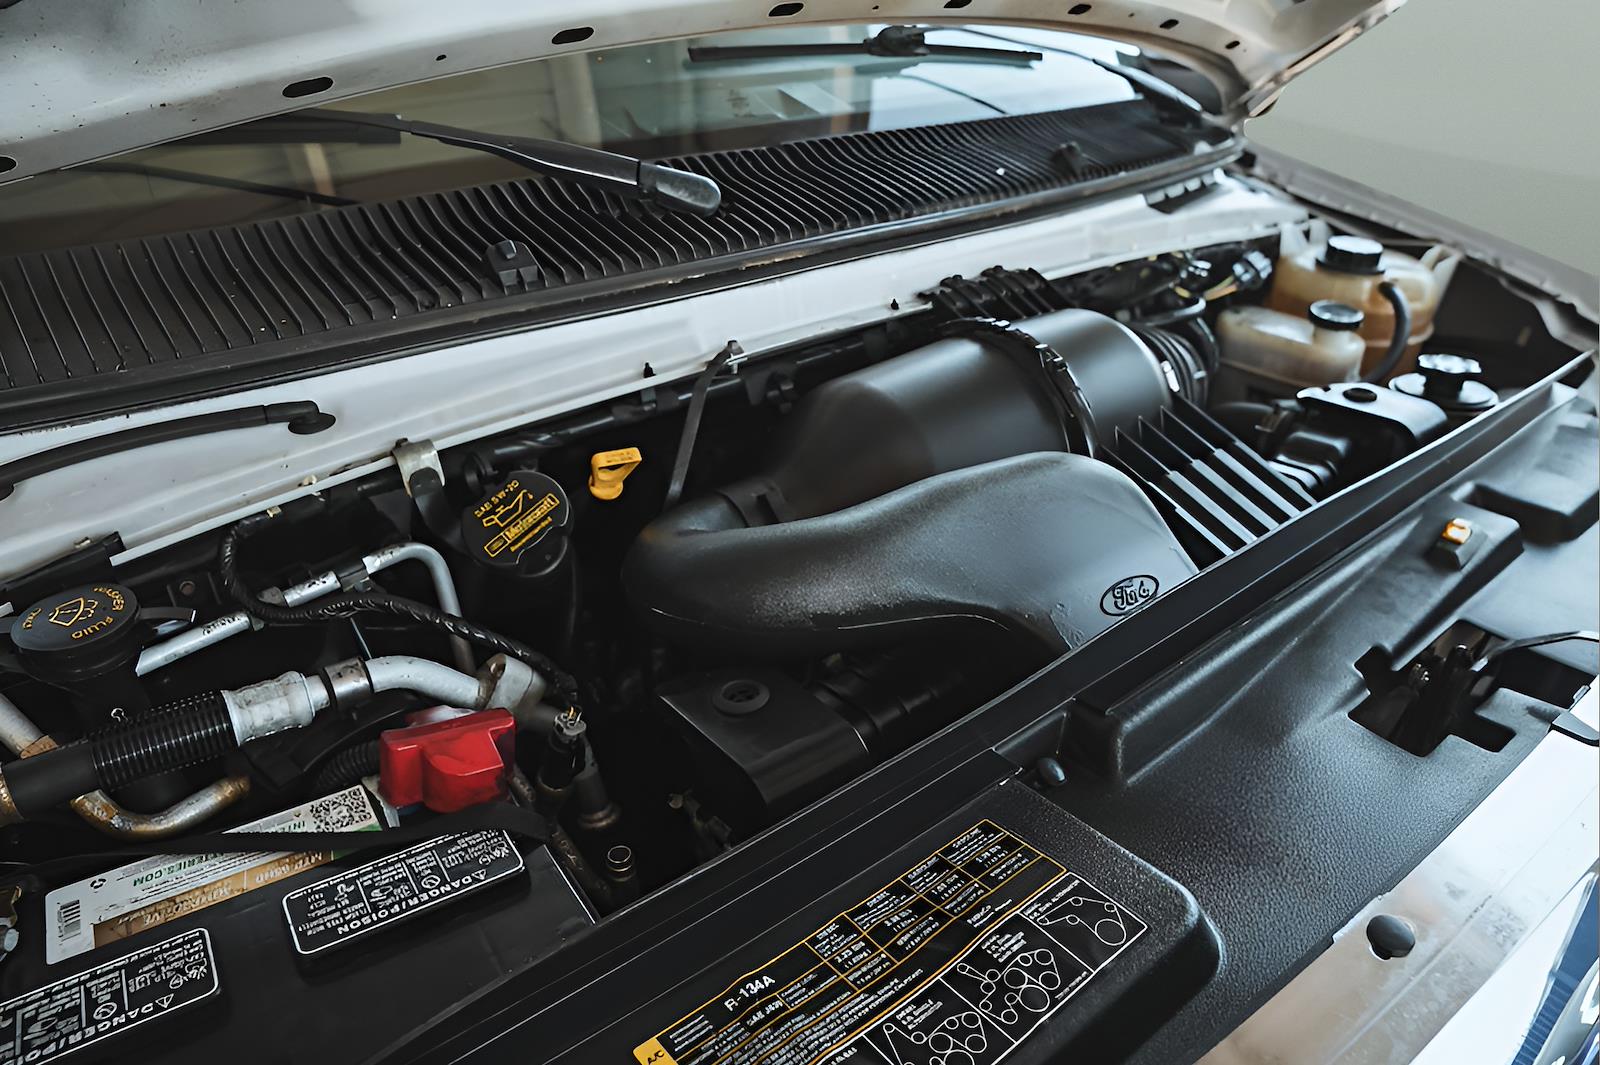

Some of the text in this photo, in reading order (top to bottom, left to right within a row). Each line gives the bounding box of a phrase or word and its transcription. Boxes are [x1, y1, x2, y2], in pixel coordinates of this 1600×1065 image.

[71, 616, 114, 639] FLUID
[337, 873, 476, 936] DANGER/POISON
[723, 976, 776, 1012] R-134A
